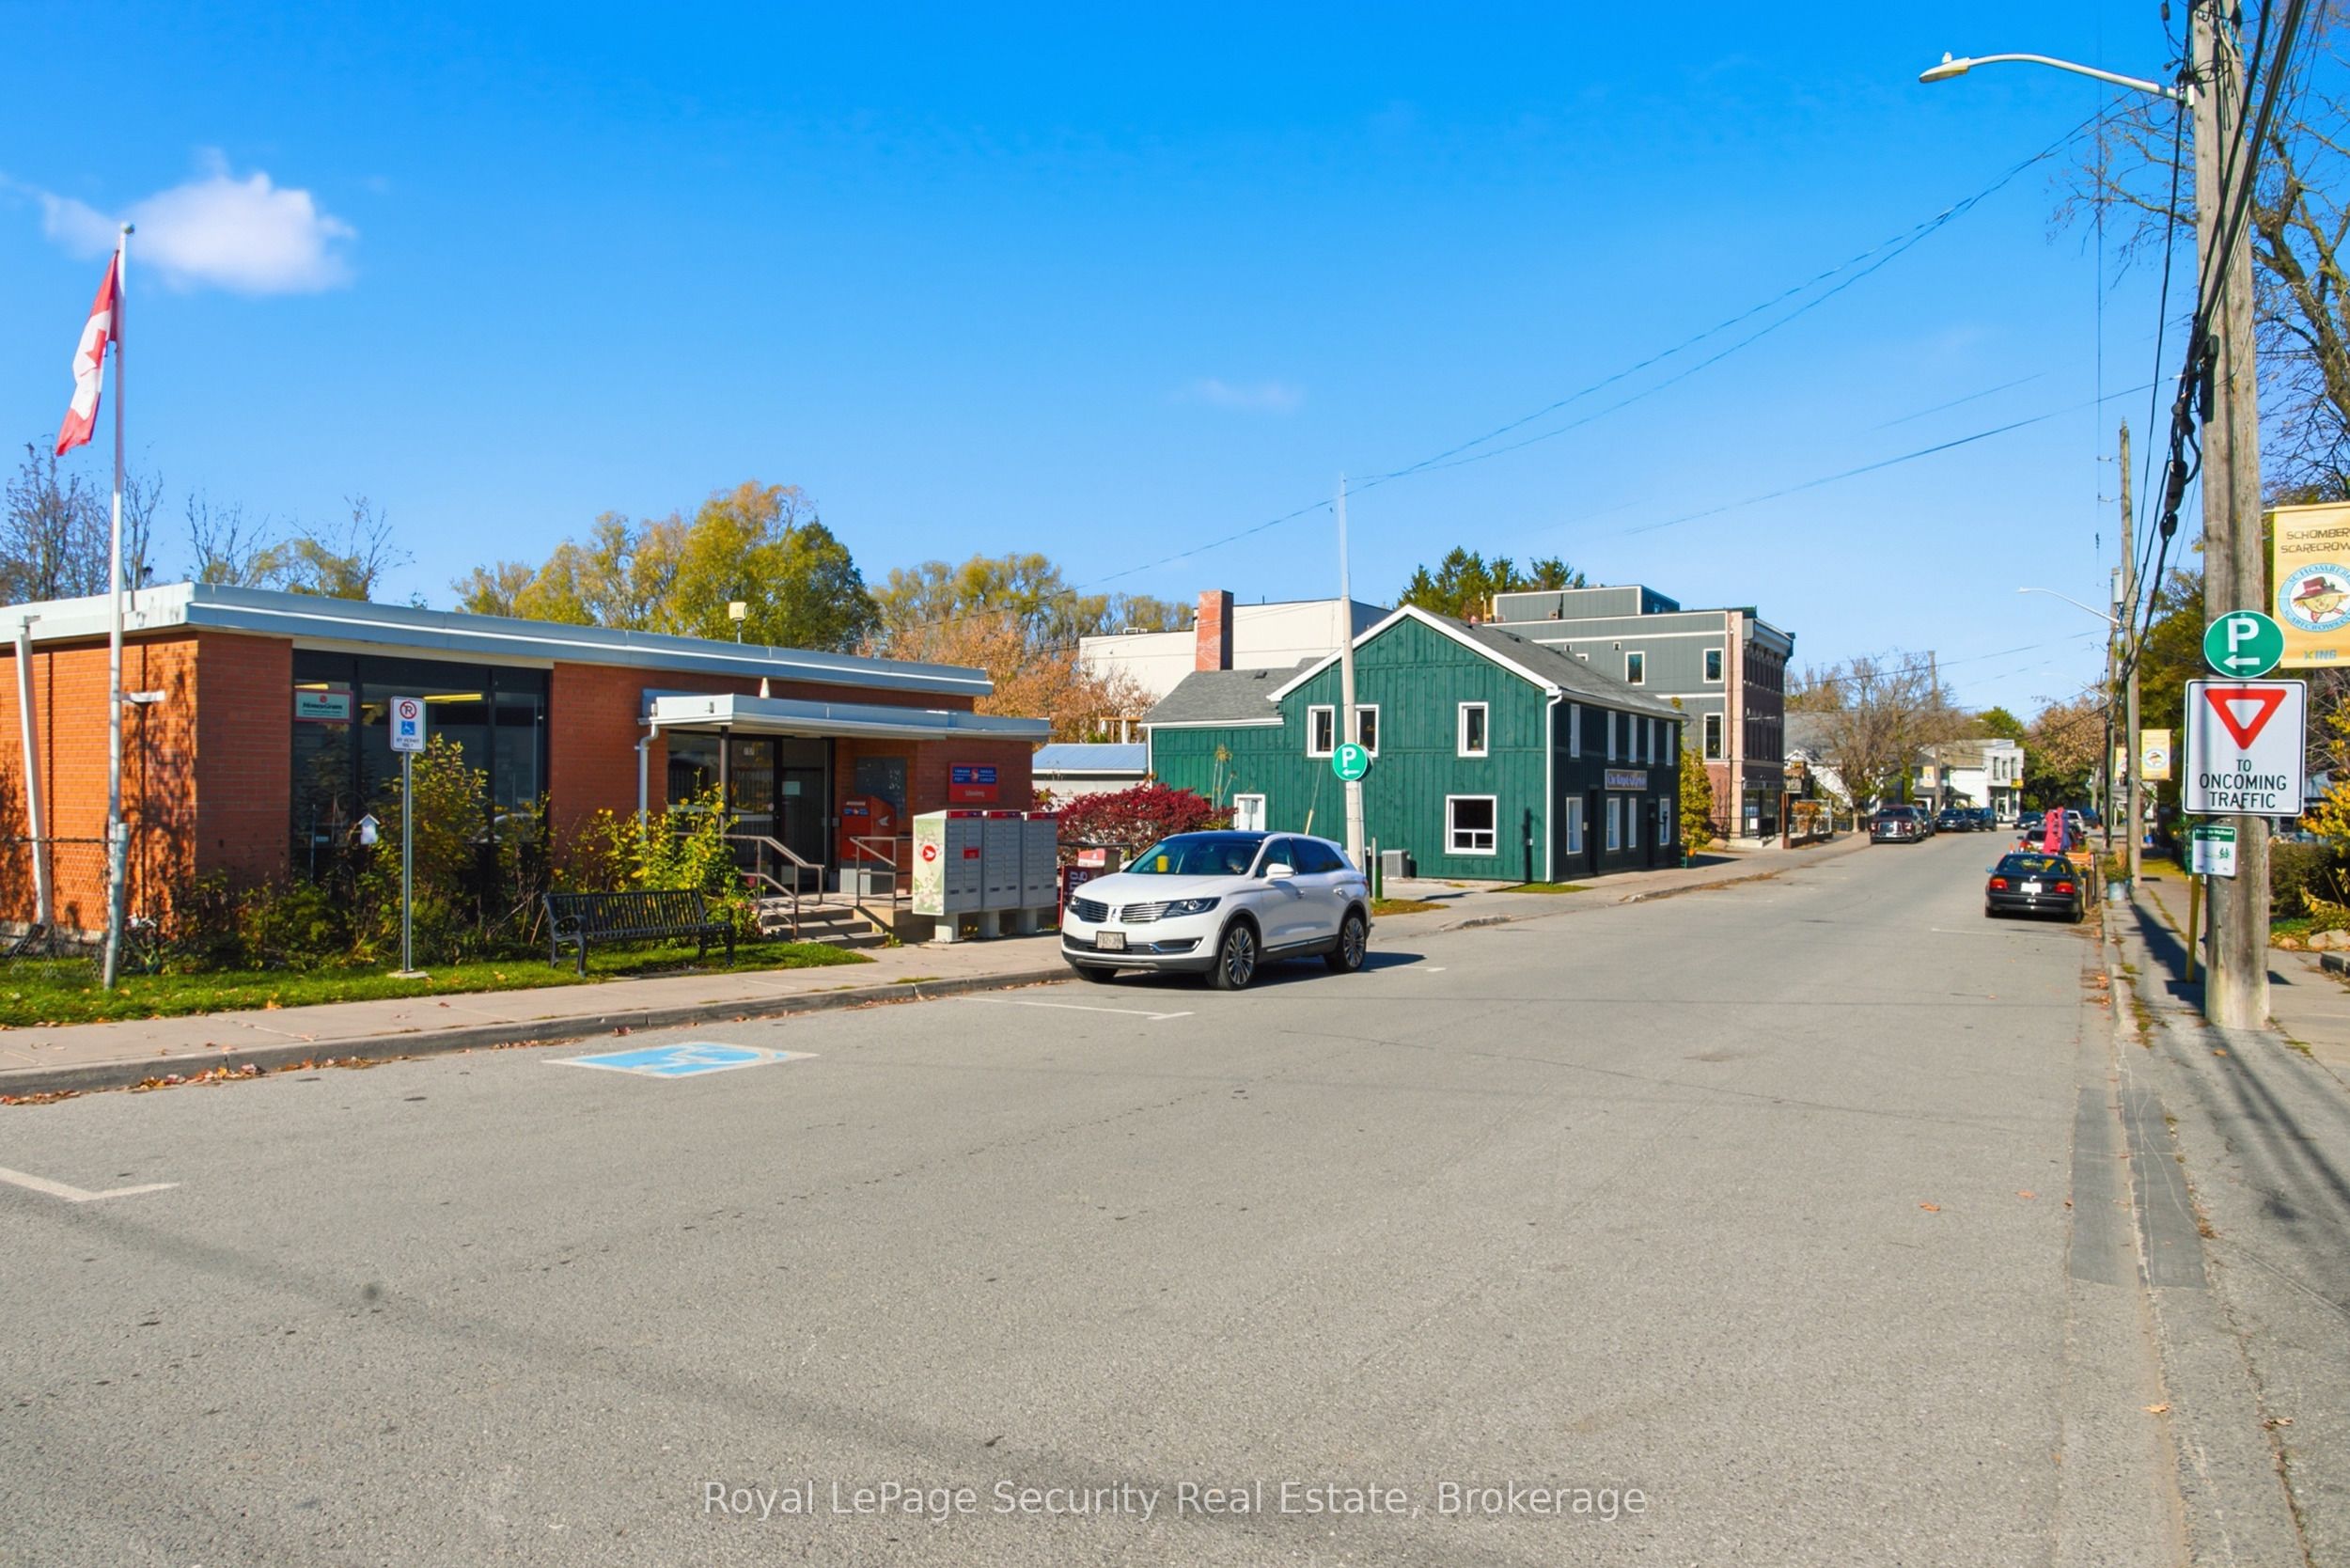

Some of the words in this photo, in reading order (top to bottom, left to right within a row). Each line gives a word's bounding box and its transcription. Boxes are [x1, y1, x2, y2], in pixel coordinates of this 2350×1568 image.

[2227, 617, 2260, 653] P
[2304, 649, 2338, 661] KING
[1341, 746, 1357, 768] P
[2236, 759, 2252, 773] TO
[2199, 773, 2287, 791] ONCOMING
[2209, 791, 2277, 808] TRAFFIC
